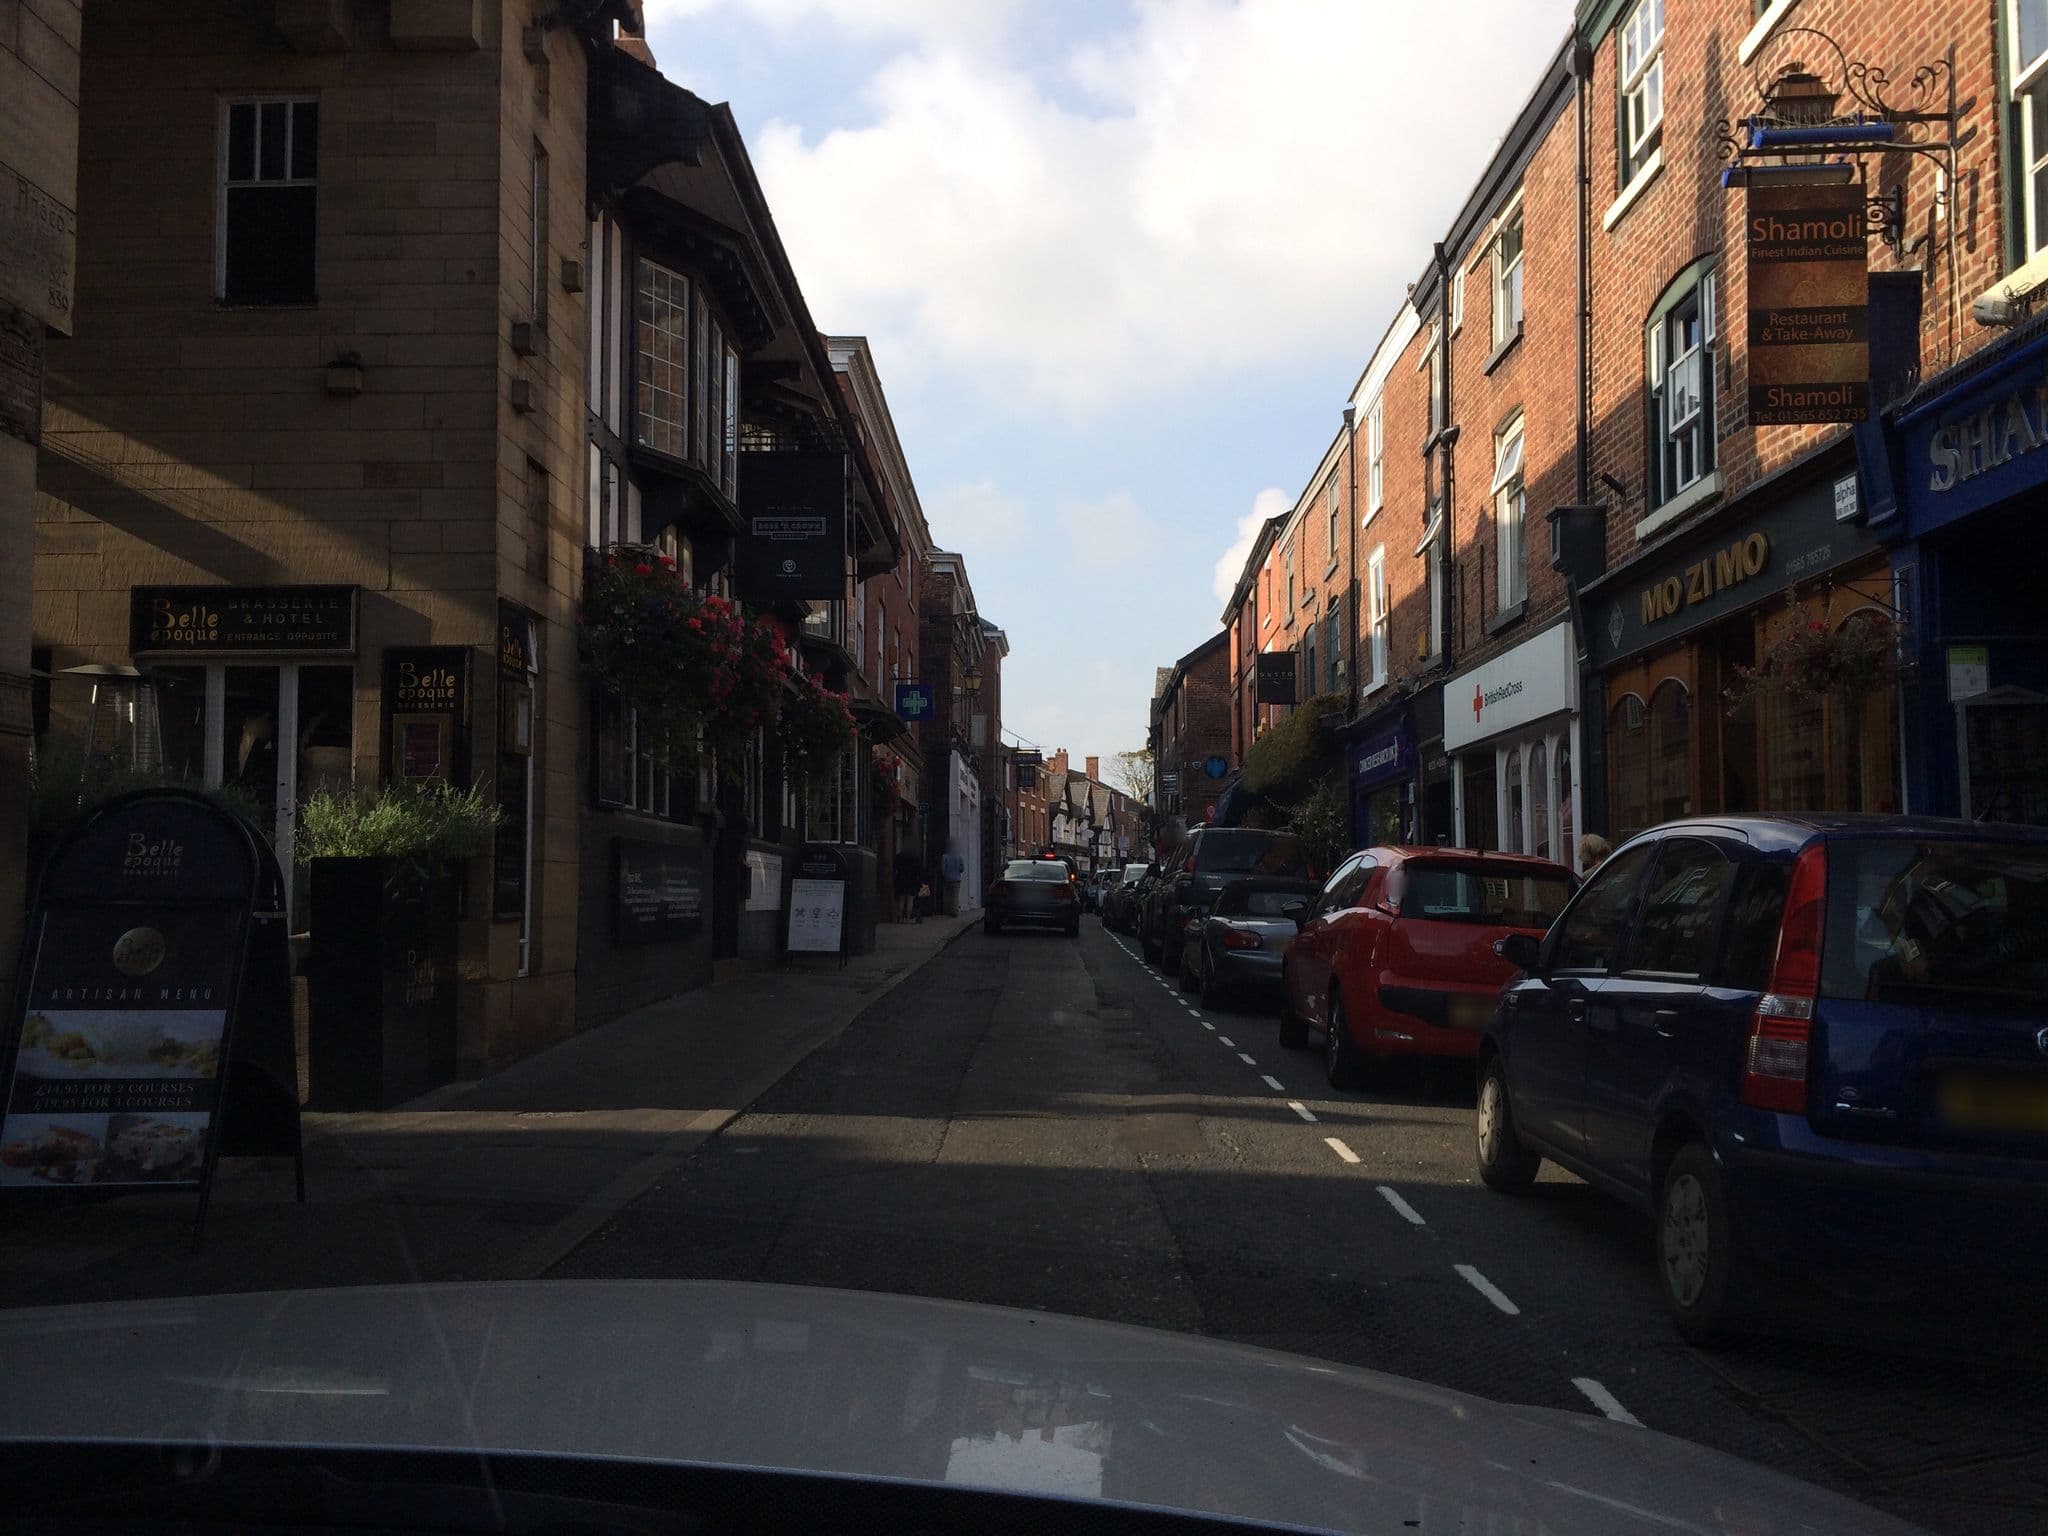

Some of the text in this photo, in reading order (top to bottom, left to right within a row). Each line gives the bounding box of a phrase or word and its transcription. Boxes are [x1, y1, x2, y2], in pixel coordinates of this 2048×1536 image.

[1752, 213, 1862, 243] Shamoli
[1752, 244, 1866, 259] Finest Indian Cuisine
[1769, 312, 1849, 326] Restaurant
[1761, 327, 1855, 342] & Take-Away
[1768, 385, 1854, 408] Shamoli
[1778, 410, 1815, 422] 01565
[1929, 385, 2048, 492] SHA
[228, 599, 340, 609] BRASSERIE
[152, 598, 219, 628] Belle
[243, 613, 325, 624] & HOTEL
[152, 627, 219, 645] epoque
[226, 631, 338, 641] ENTRANCE OPPOSITE
[399, 662, 456, 688] Belle
[398, 687, 456, 701] epoque
[128, 833, 184, 856] Belle
[51, 988, 213, 1001] ARTISAN MENU
[84, 1082, 112, 1094] FOR
[128, 1080, 194, 1094] COURSES
[82, 1096, 110, 1107] FOR
[126, 1095, 192, 1106] COURSES
